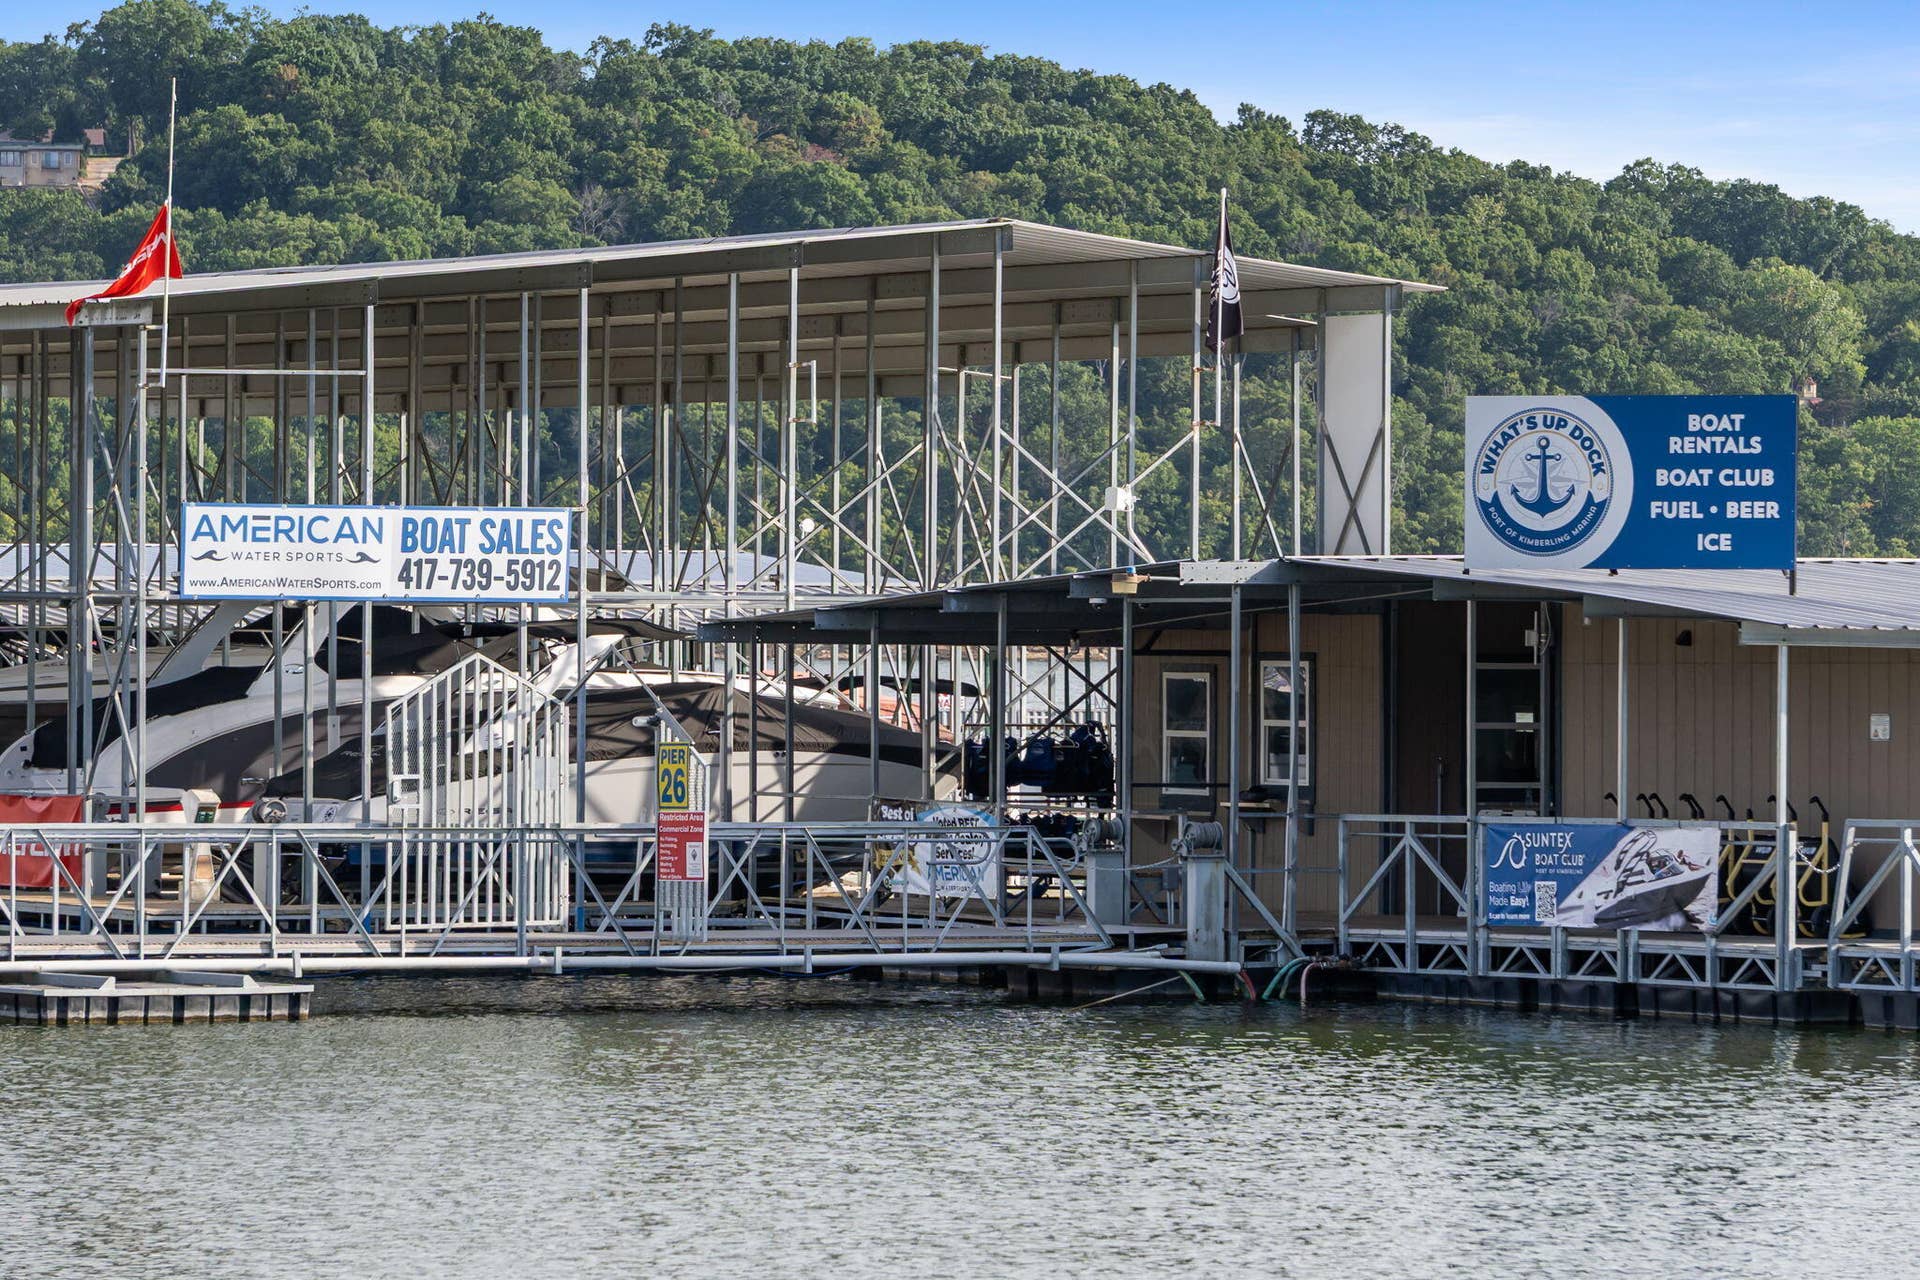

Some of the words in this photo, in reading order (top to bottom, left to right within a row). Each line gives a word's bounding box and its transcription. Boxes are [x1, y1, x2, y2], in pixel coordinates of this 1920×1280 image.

[1688, 414, 1745, 431] BOAT
[1480, 415, 1538, 474] WHAT'S
[1542, 415, 1569, 431] UP
[1569, 425, 1606, 477] DOCK
[1669, 437, 1761, 454] RENTALS
[1656, 469, 1713, 486] BOAT
[1719, 469, 1775, 487] CLUB
[1650, 502, 1704, 519] FUEL
[1726, 502, 1780, 519] BEER
[191, 513, 384, 545] AMERICAN
[1488, 506, 1506, 528] PORT
[1505, 528, 1518, 538] OF
[1519, 533, 1571, 547] KIMBERLING
[1571, 505, 1598, 536] MARINA
[400, 516, 471, 554] BOAT
[478, 517, 564, 555] SALES
[1697, 534, 1732, 551] ICE
[231, 551, 280, 562] WATER
[285, 551, 343, 563] SPORTS
[398, 558, 562, 591] 417-739-5912
[661, 749, 686, 764] PIER
[661, 768, 686, 803] 26
[689, 813, 704, 821] Area
[690, 825, 704, 833] Zone
[1525, 832, 1575, 853] SUNTEX
[1535, 854, 1559, 865] BOAT
[1561, 854, 1584, 866] CLUB
[1489, 881, 1516, 894] Boating
[1489, 896, 1508, 906] Made
[1510, 896, 1529, 908] Easy!
